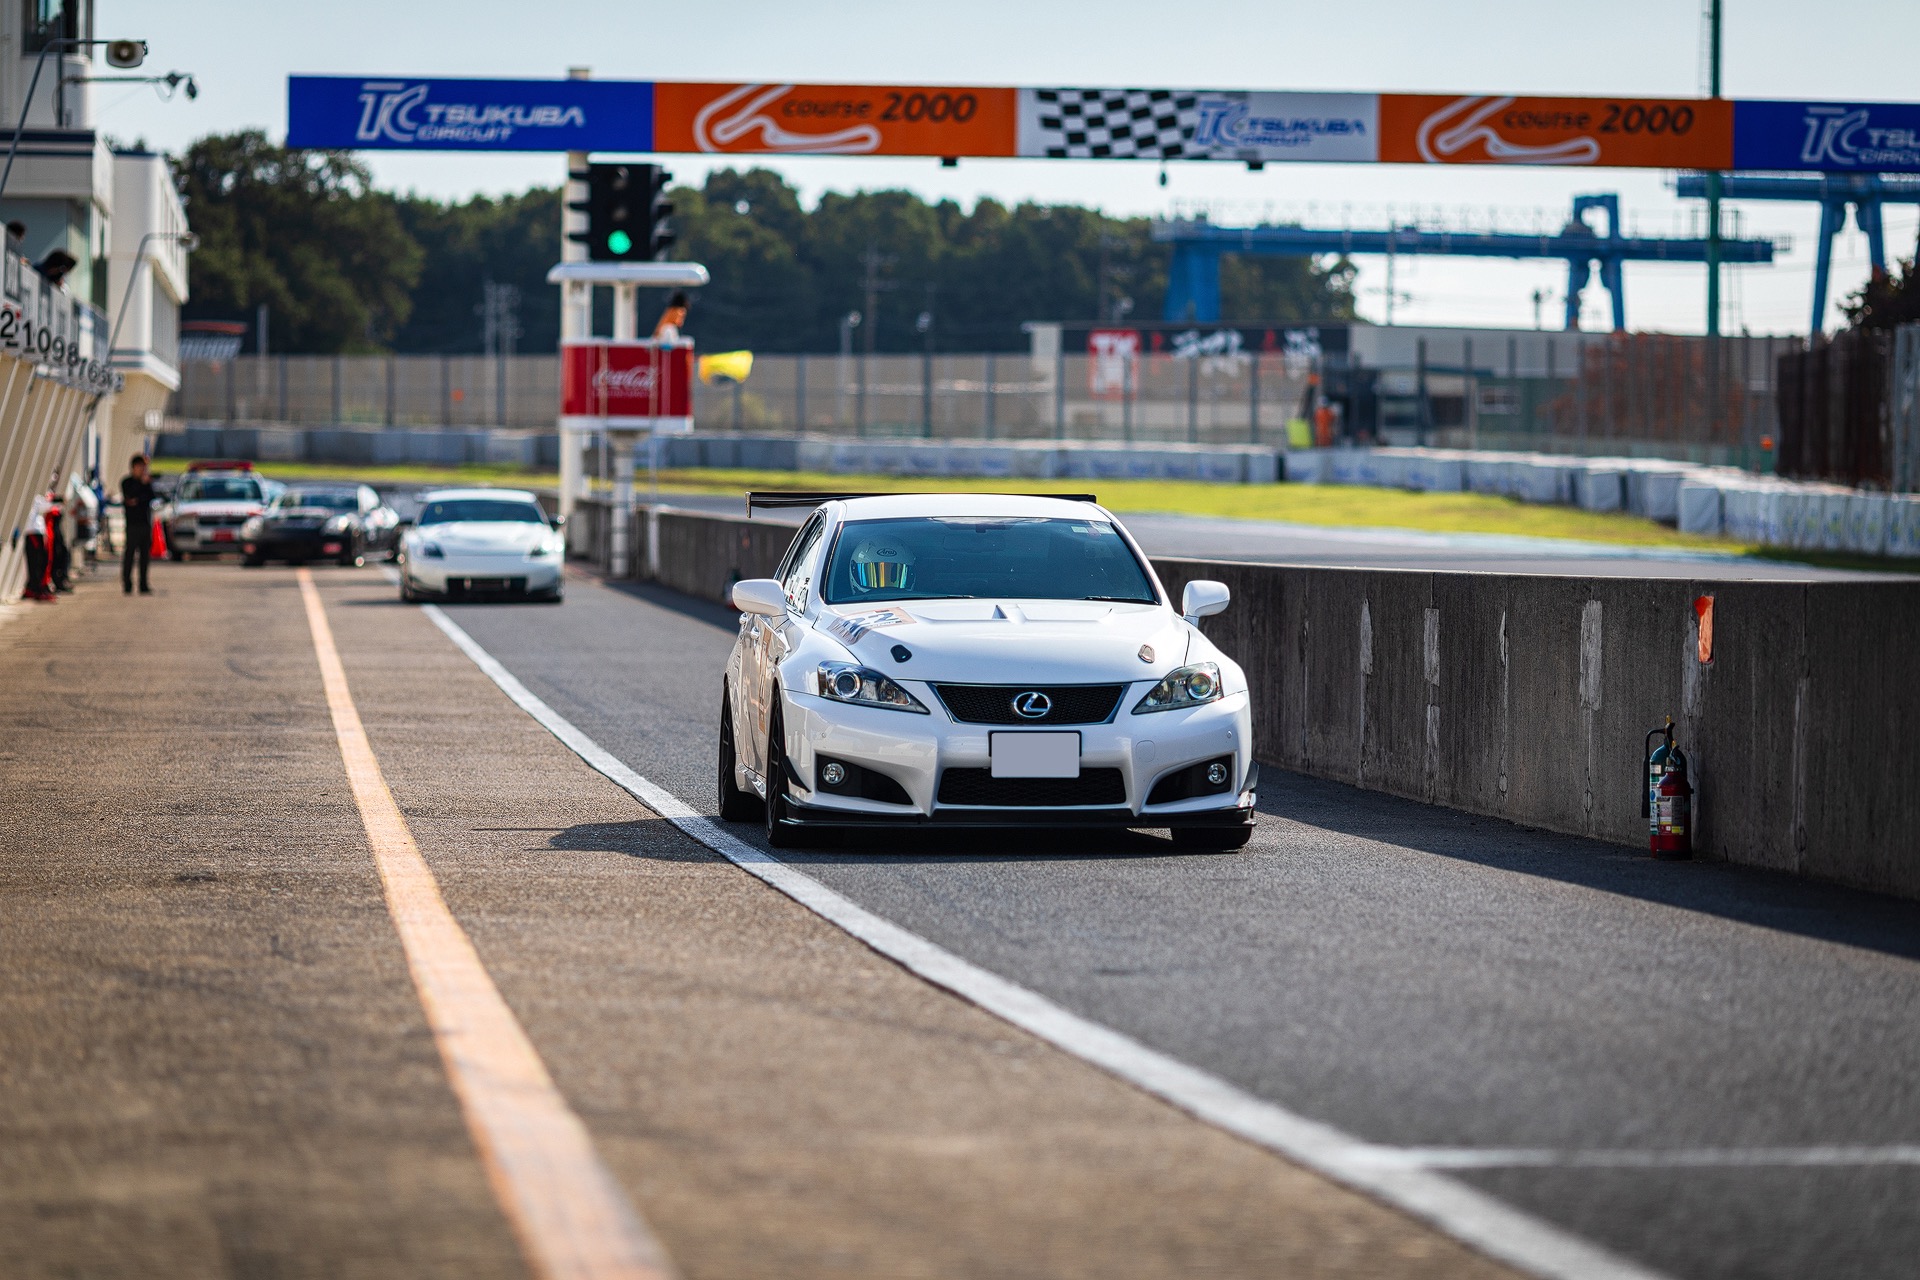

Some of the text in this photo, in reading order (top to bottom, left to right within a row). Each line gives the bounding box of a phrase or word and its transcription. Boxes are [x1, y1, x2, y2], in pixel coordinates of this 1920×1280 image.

[424, 104, 586, 127] TSUKUBA
[782, 92, 978, 124] course 2000
[1248, 116, 1367, 136] TSUKUBA
[1503, 104, 1695, 136] course 2000
[415, 124, 513, 142] CIRCUIT
